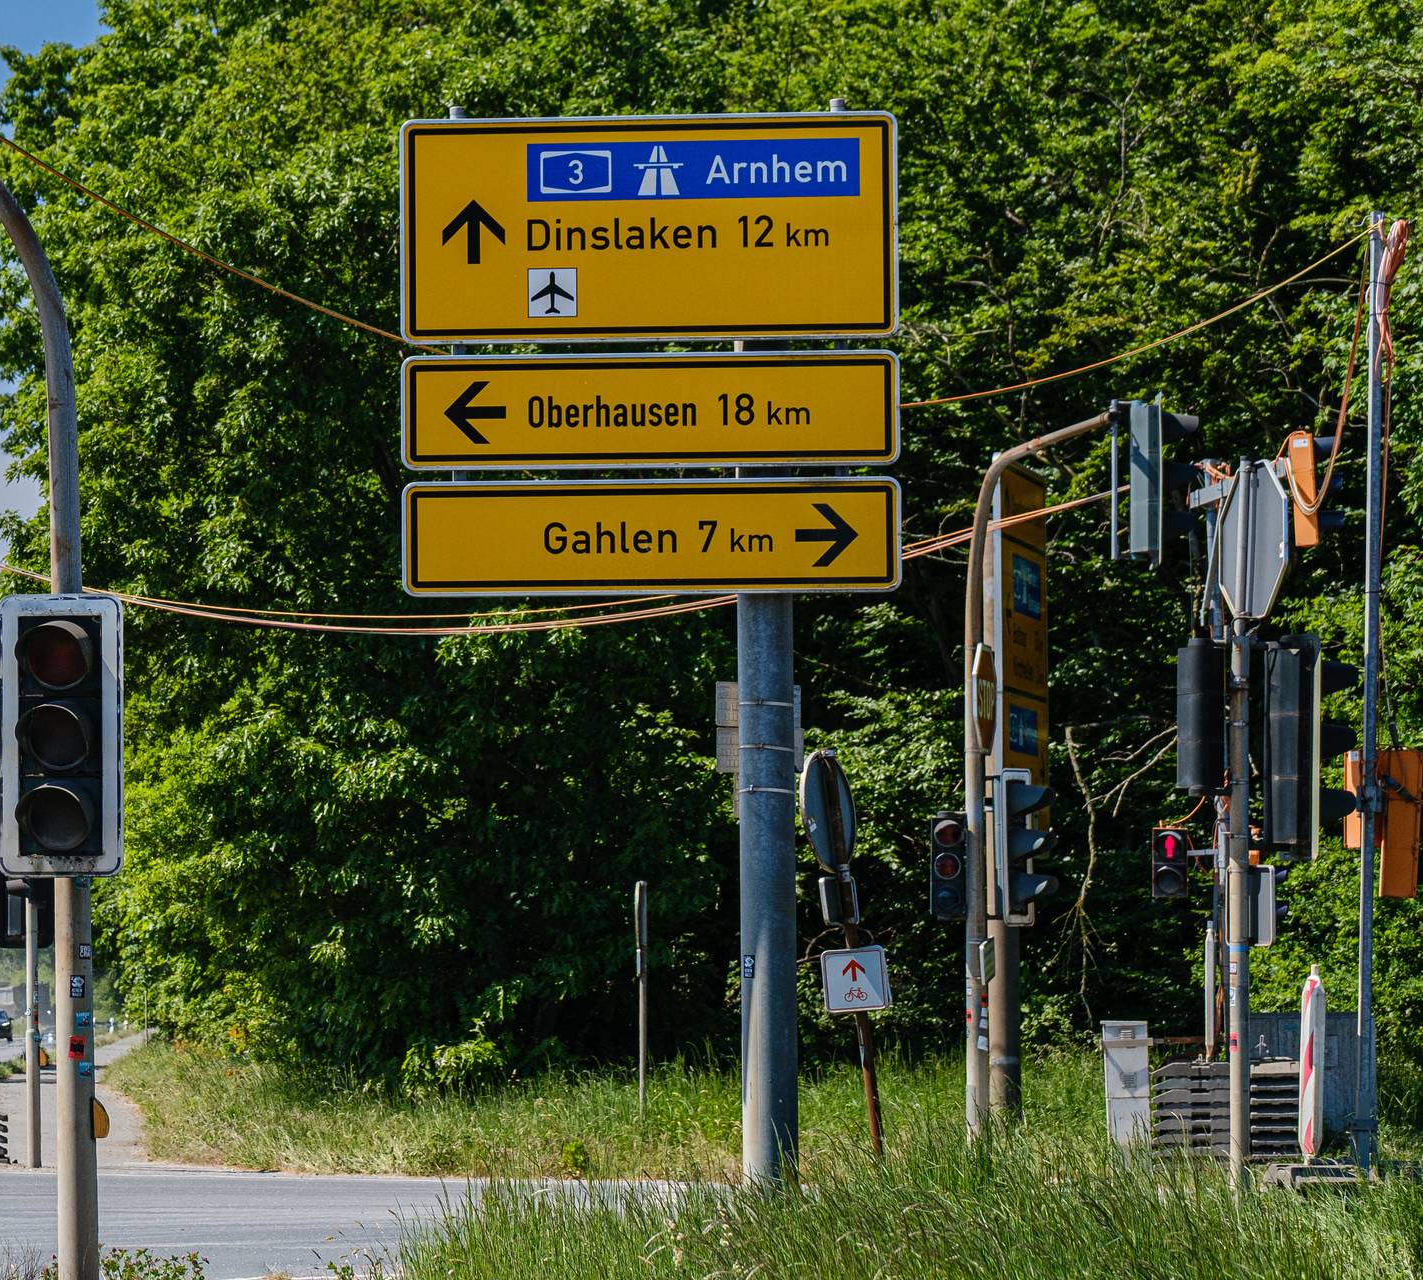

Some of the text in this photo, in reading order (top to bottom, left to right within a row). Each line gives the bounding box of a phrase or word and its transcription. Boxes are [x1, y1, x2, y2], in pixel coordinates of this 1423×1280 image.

[567, 154, 848, 185] 3 Arnhem
[526, 214, 829, 252] Dinslaken 12 km
[528, 393, 811, 428] Oberhausen 18 km
[544, 520, 773, 555] Gahlen 7 km
[978, 678, 995, 720] STOP
